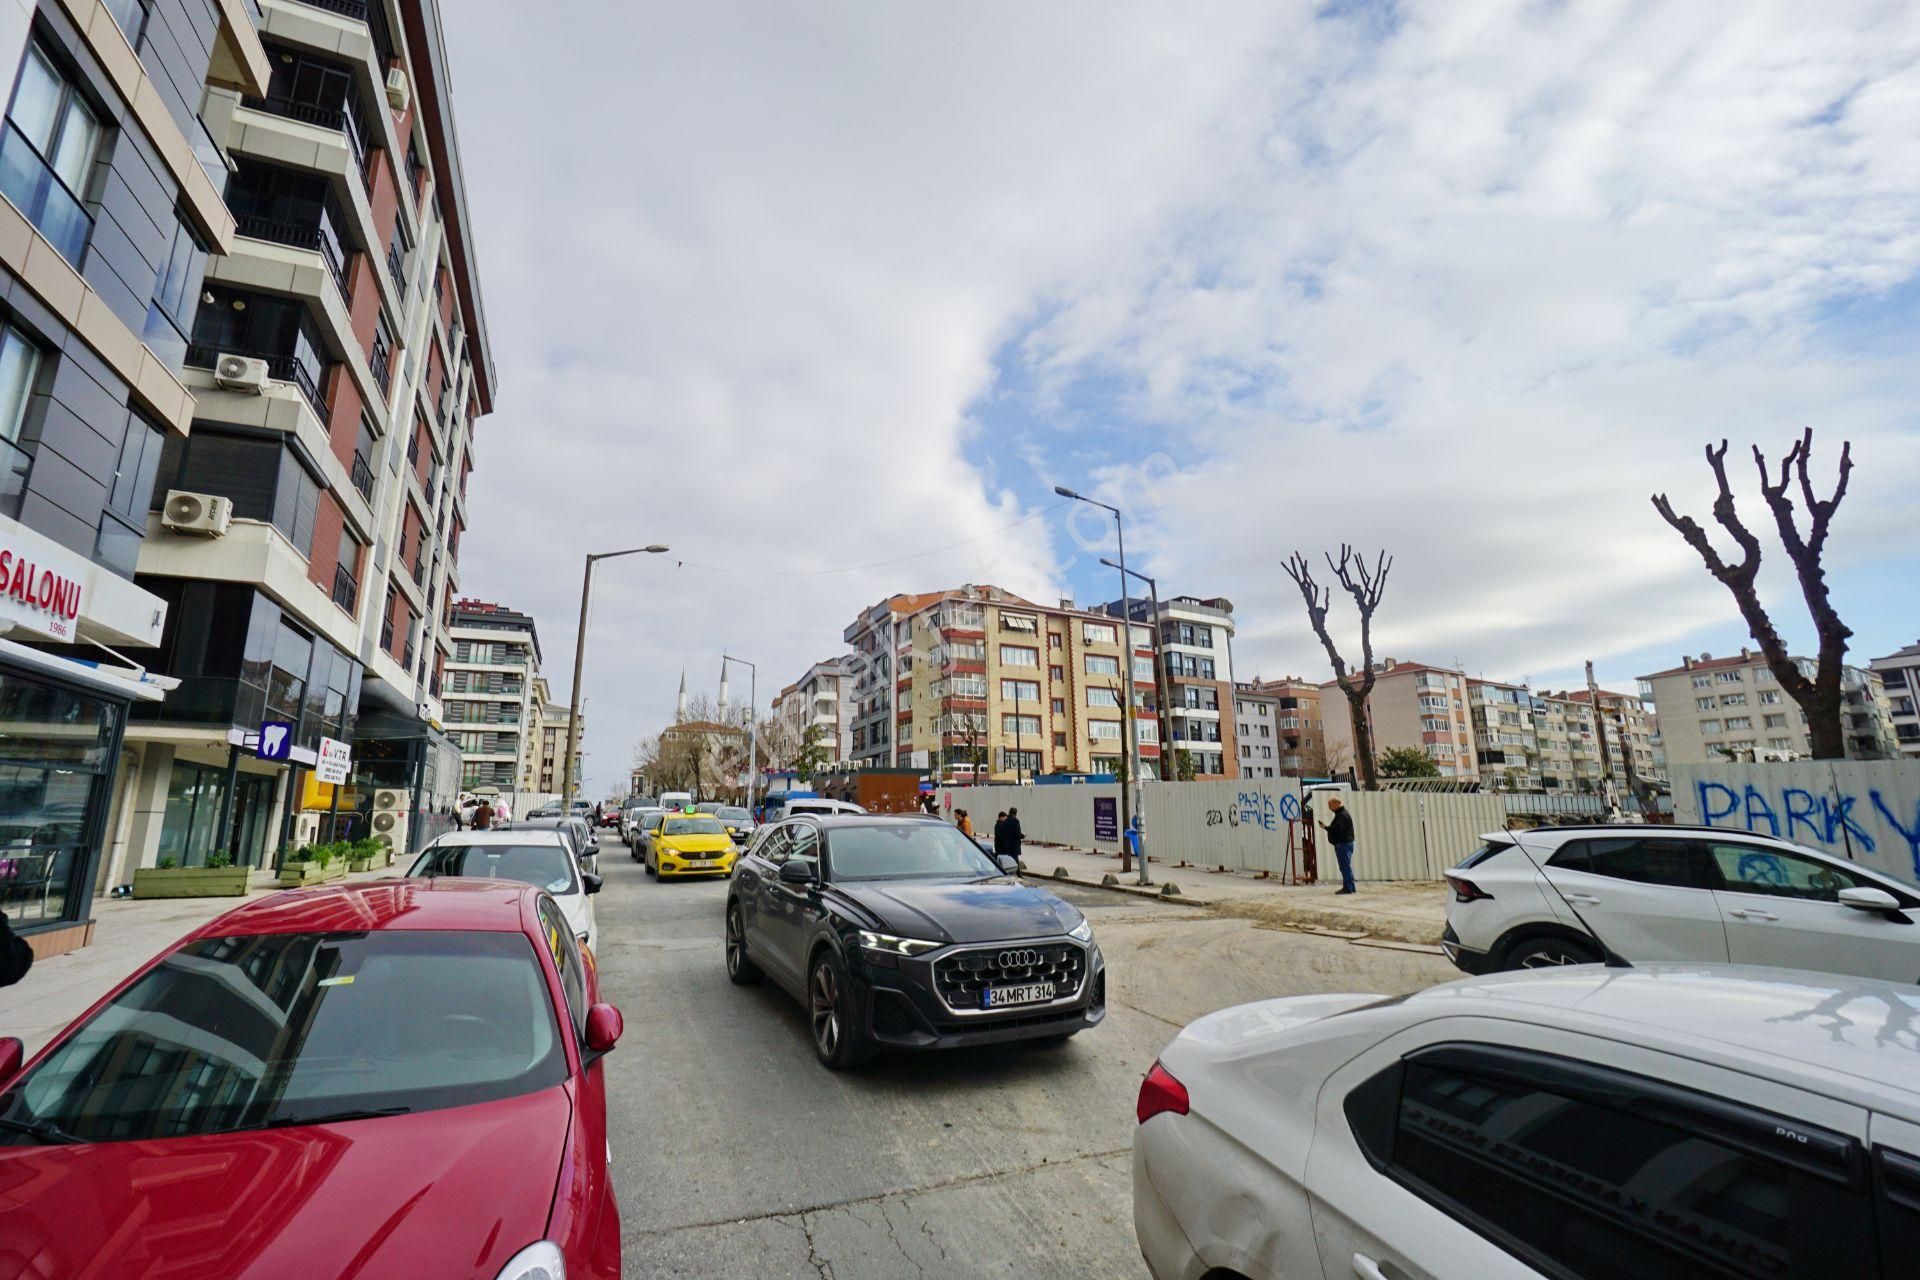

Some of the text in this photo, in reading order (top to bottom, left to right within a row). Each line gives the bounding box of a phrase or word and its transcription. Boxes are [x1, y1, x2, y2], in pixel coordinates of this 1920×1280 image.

[0, 550, 82, 620] SALONU
[48, 621, 67, 637] 1986
[1238, 791, 1275, 812] PARK
[1694, 780, 1876, 853] PARK
[990, 990, 1005, 1004] 34
[1006, 986, 1033, 1003] MRT
[1035, 984, 1053, 999] 314
